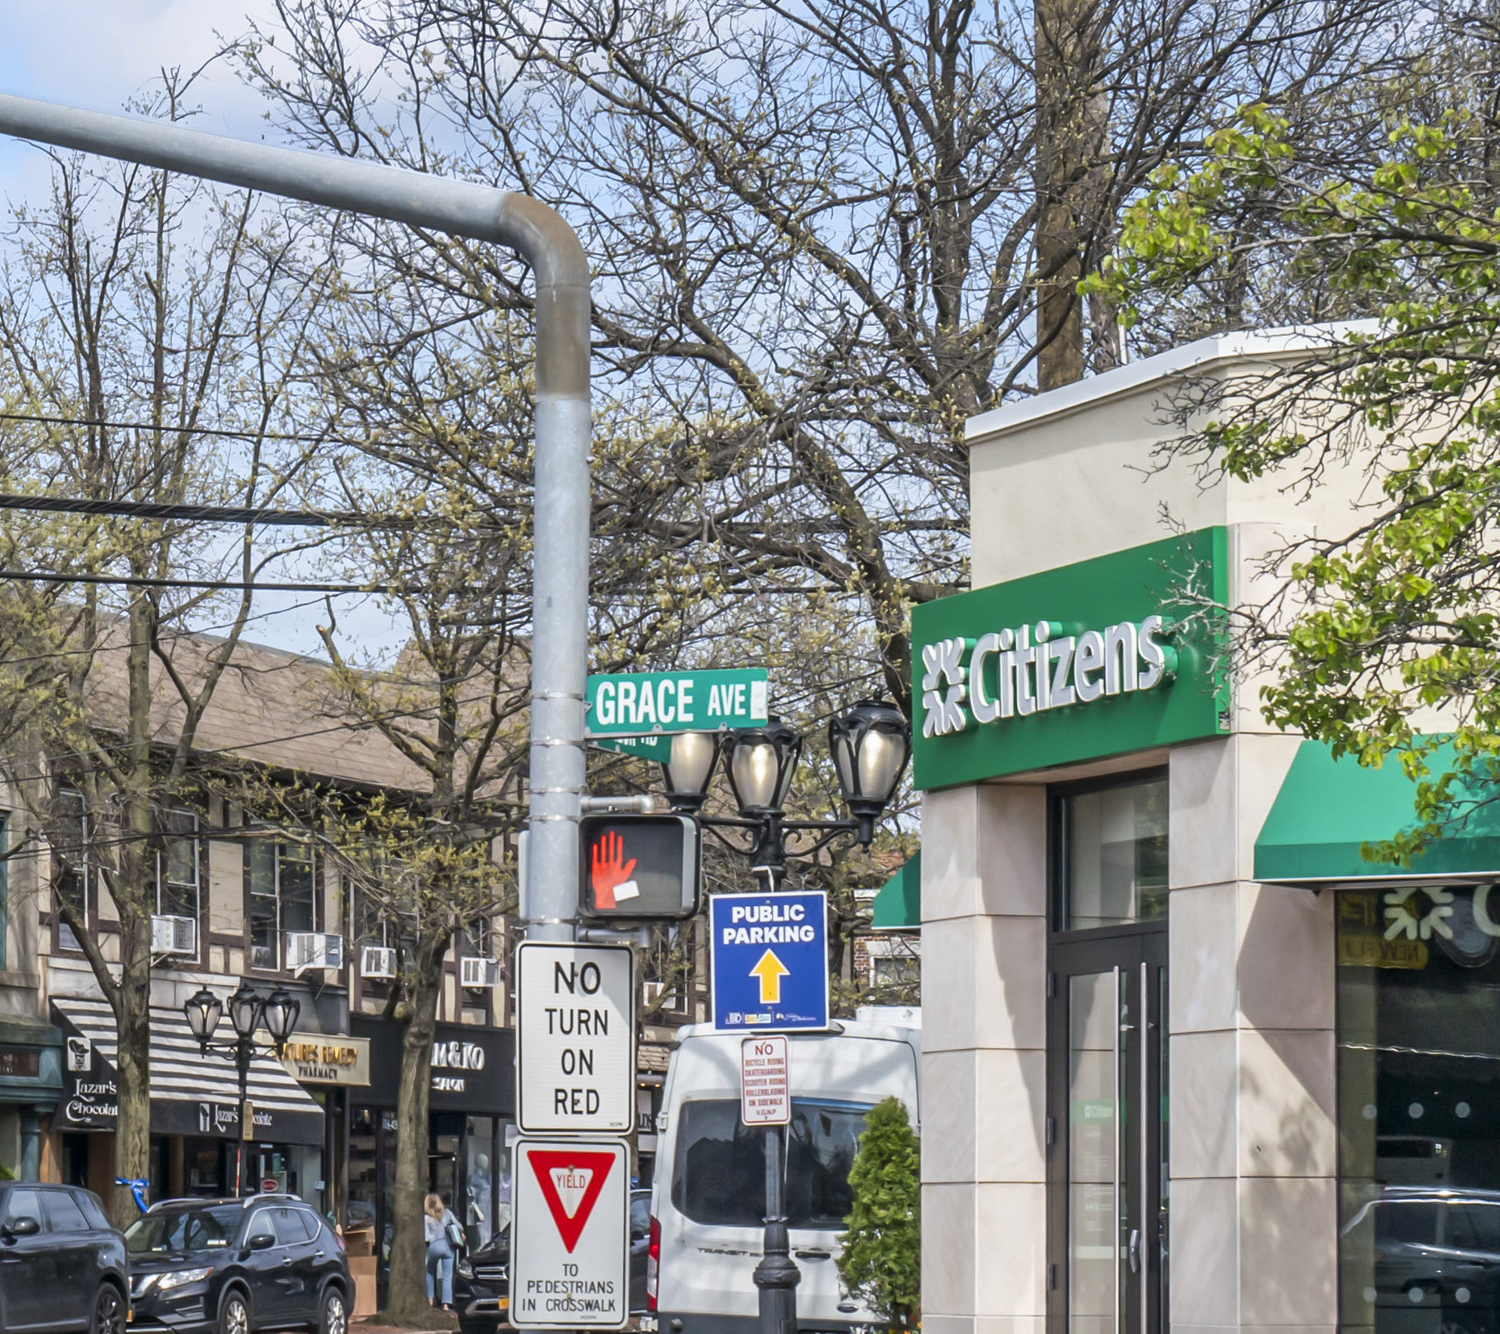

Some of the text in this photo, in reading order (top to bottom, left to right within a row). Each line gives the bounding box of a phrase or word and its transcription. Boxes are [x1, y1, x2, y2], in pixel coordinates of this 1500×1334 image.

[969, 615, 1166, 724] Citizens
[596, 679, 746, 726] GRACE AVE
[731, 904, 805, 923] PUBLIC
[722, 925, 815, 945] PARKING
[554, 961, 601, 995] NO
[544, 1008, 608, 1036] TURN
[755, 1044, 774, 1056] NO
[561, 1048, 593, 1076] ON
[298, 1066, 338, 1079] PHARMACY
[73, 1078, 117, 1102] Lazar's
[66, 1099, 118, 1123] Chocolat
[554, 1088, 600, 1115] RED
[556, 1174, 586, 1189] YIELD
[697, 1247, 748, 1256] TRANSIT
[562, 1263, 579, 1277] TO
[527, 1280, 614, 1295] PEDESTRIANS
[522, 1298, 616, 1312] IN CROSSWALK
